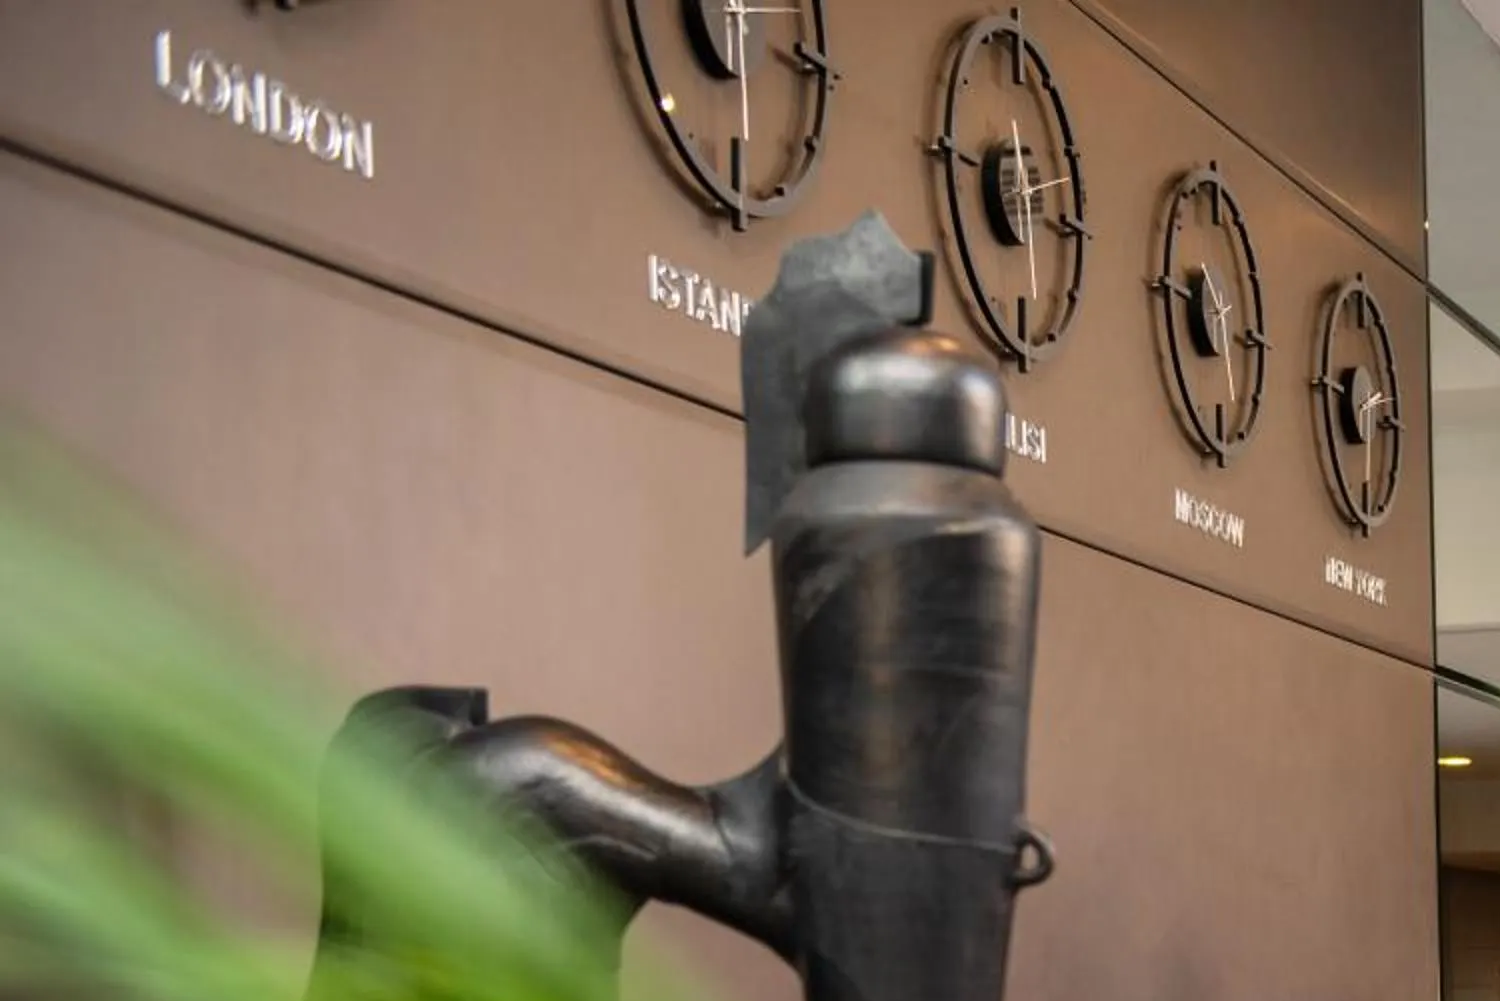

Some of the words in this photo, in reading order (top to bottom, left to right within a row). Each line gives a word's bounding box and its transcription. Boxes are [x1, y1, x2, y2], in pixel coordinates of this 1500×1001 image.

[156, 29, 375, 180] LONDON
[648, 253, 754, 337] ISTAN
[1004, 410, 1047, 464] ILISI
[1175, 486, 1244, 548] MOSCOW
[1325, 554, 1353, 591] NEW
[1355, 568, 1388, 608] YORK
